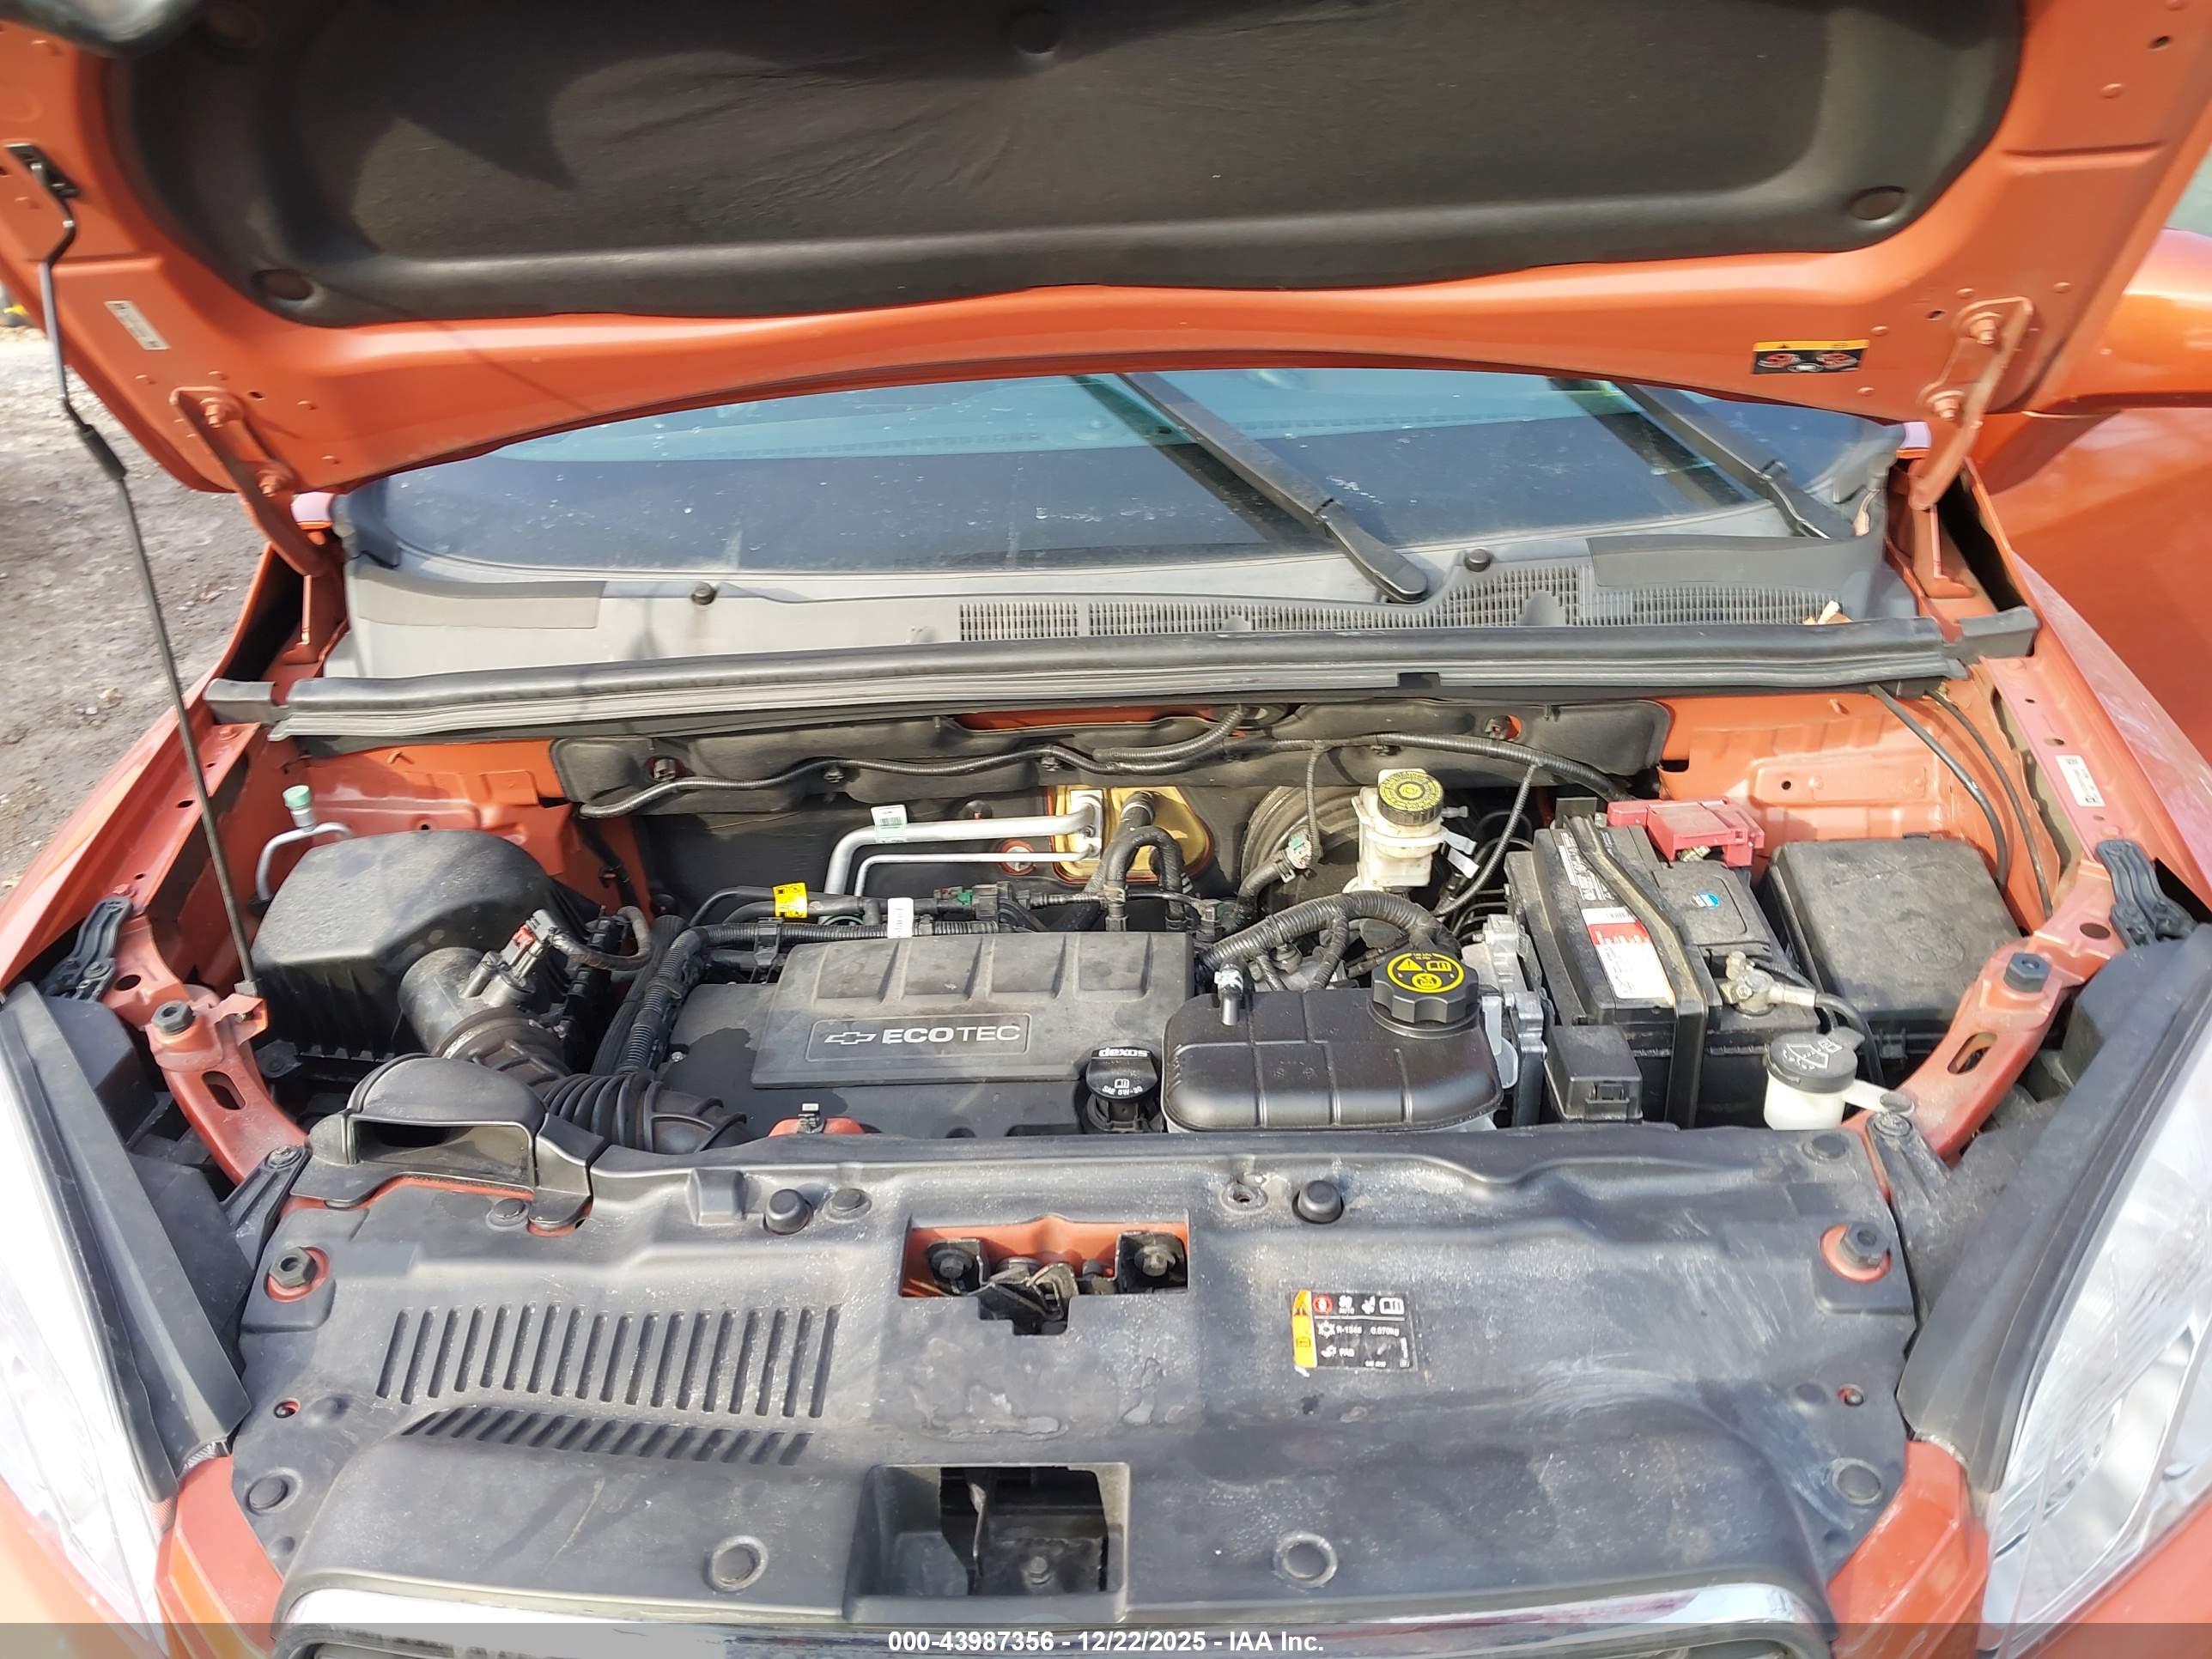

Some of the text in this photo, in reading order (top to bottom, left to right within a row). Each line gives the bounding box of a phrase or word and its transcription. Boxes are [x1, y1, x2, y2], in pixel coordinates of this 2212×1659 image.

[882, 1025, 1021, 1044] ECOTEC
[1099, 1048, 1151, 1058] dexos
[1102, 1085, 1116, 1096] SAE
